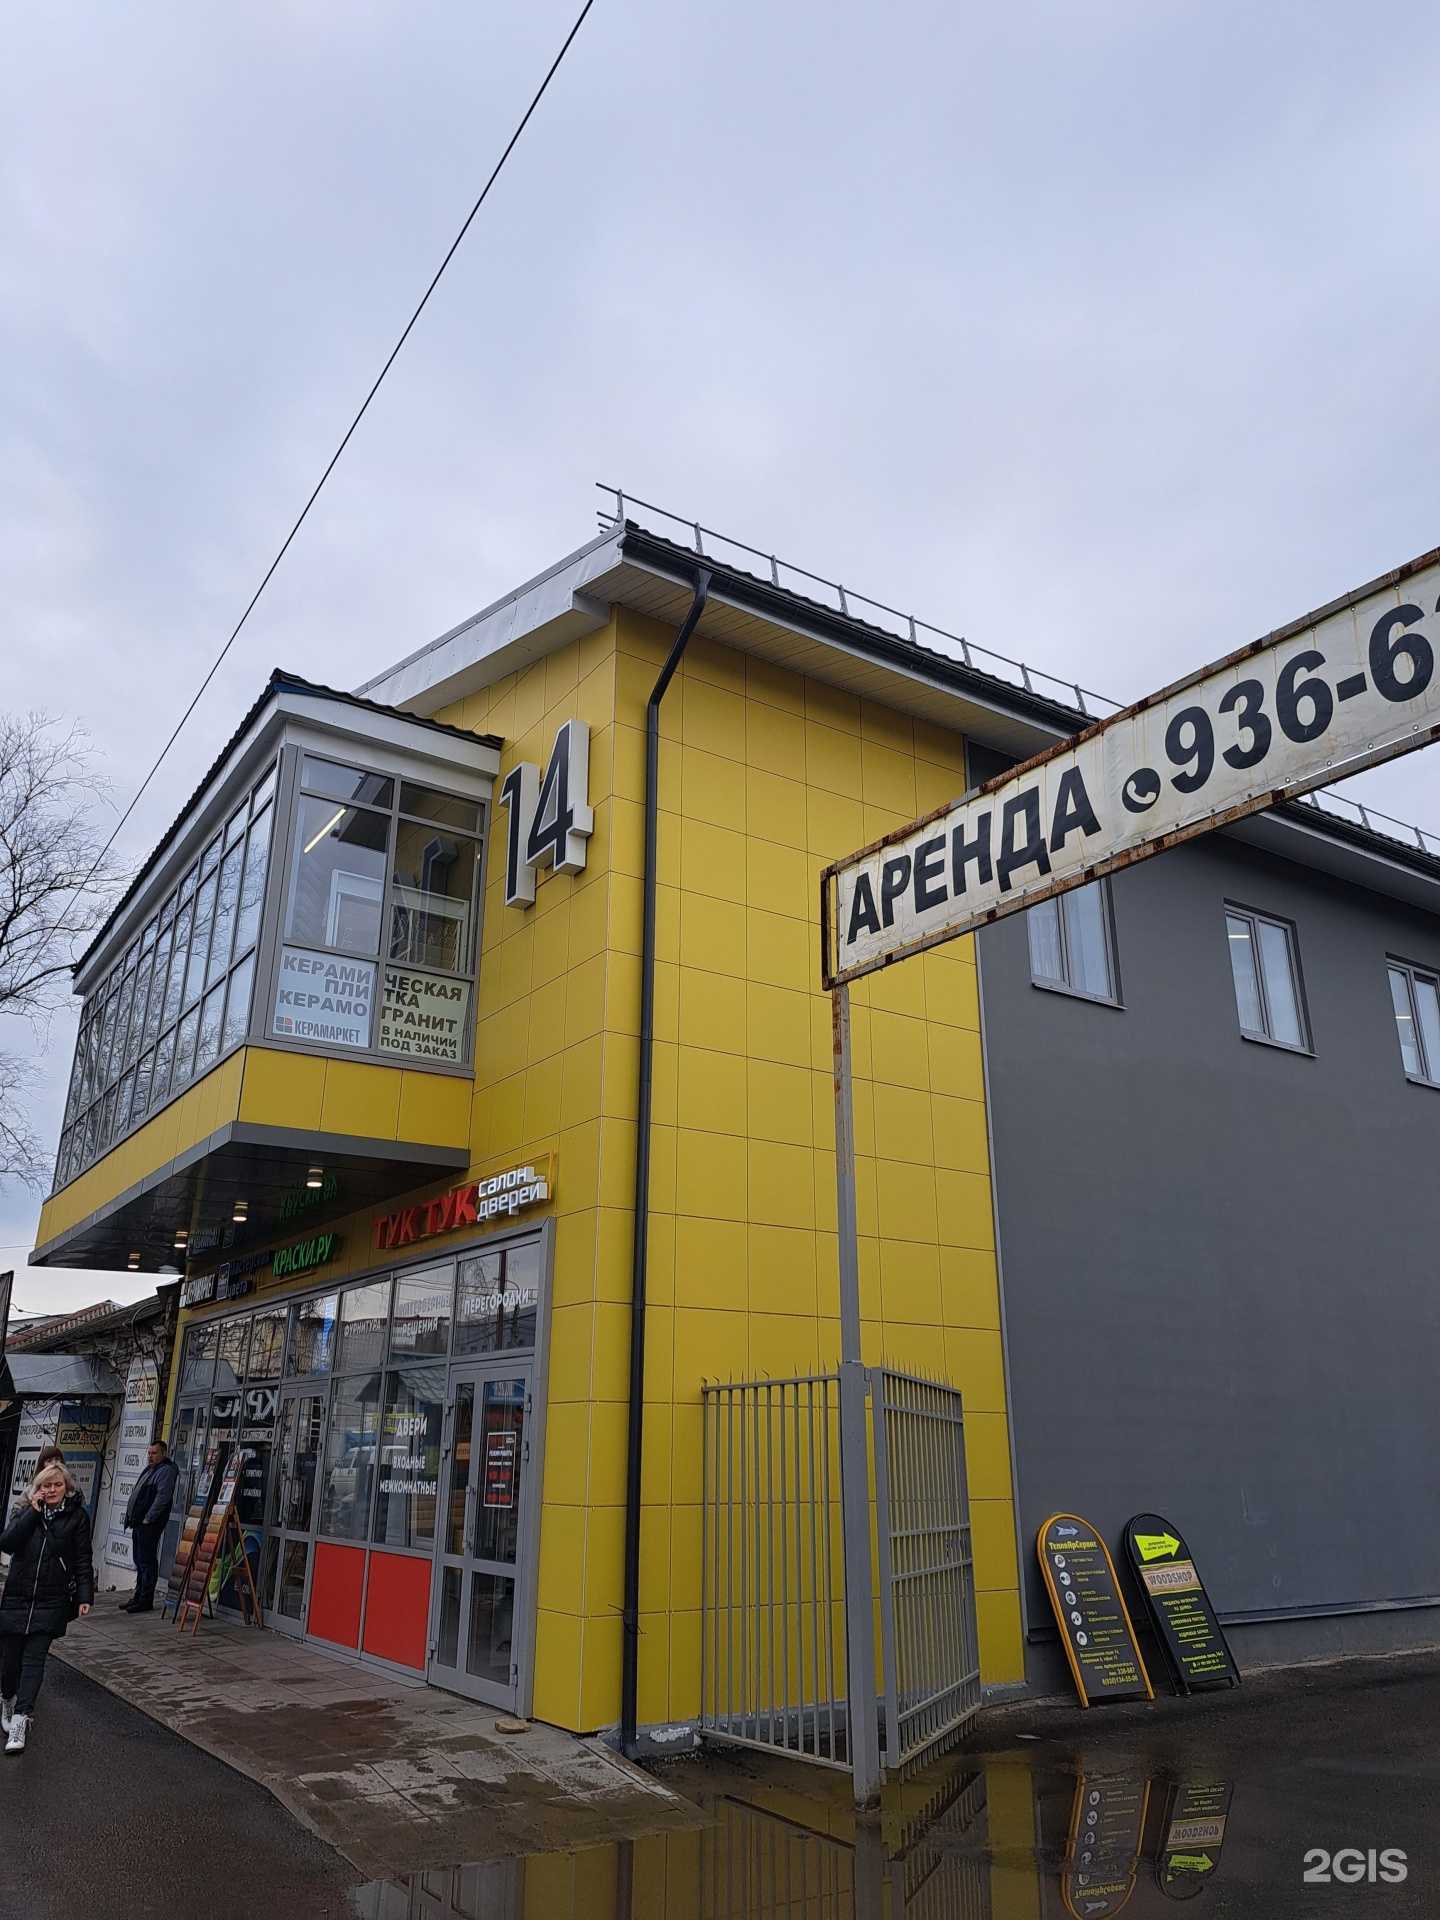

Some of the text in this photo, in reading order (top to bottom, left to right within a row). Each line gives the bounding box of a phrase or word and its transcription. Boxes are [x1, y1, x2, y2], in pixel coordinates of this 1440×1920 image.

[846, 602, 1440, 945] АРЕНДА 936-6
[499, 719, 592, 909] 14
[283, 955, 463, 1001] КЕРАМИ ЧЕСКАЯ
[325, 979, 420, 1009] ПЛИ ТКА
[279, 989, 458, 1033] КЕРАМО ГРАНИТ
[294, 1019, 361, 1044] КЕРАМАРКЕТ
[382, 1025, 457, 1049] В НАЛИЧИИ
[380, 1037, 457, 1060] ПОД ЗАКАЗ
[478, 1167, 533, 1198] салон
[477, 1182, 544, 1222] дверей
[373, 1185, 478, 1249] ТУК ТУК
[272, 1233, 333, 1277] КРАСКИ.РУ
[464, 1287, 529, 1315] ПЕРЕГОРОДКИ
[343, 1319, 381, 1337] ФУРНИТУРА
[402, 1317, 438, 1336] РЕШЕНИЯ
[397, 1416, 428, 1437] ДВЕРИ
[392, 1455, 426, 1471] ВХОДНЫЕ
[379, 1479, 438, 1496] МЕЖКОМНАТНЫЕ
[1149, 1570, 1193, 1586] WOODSHOP
